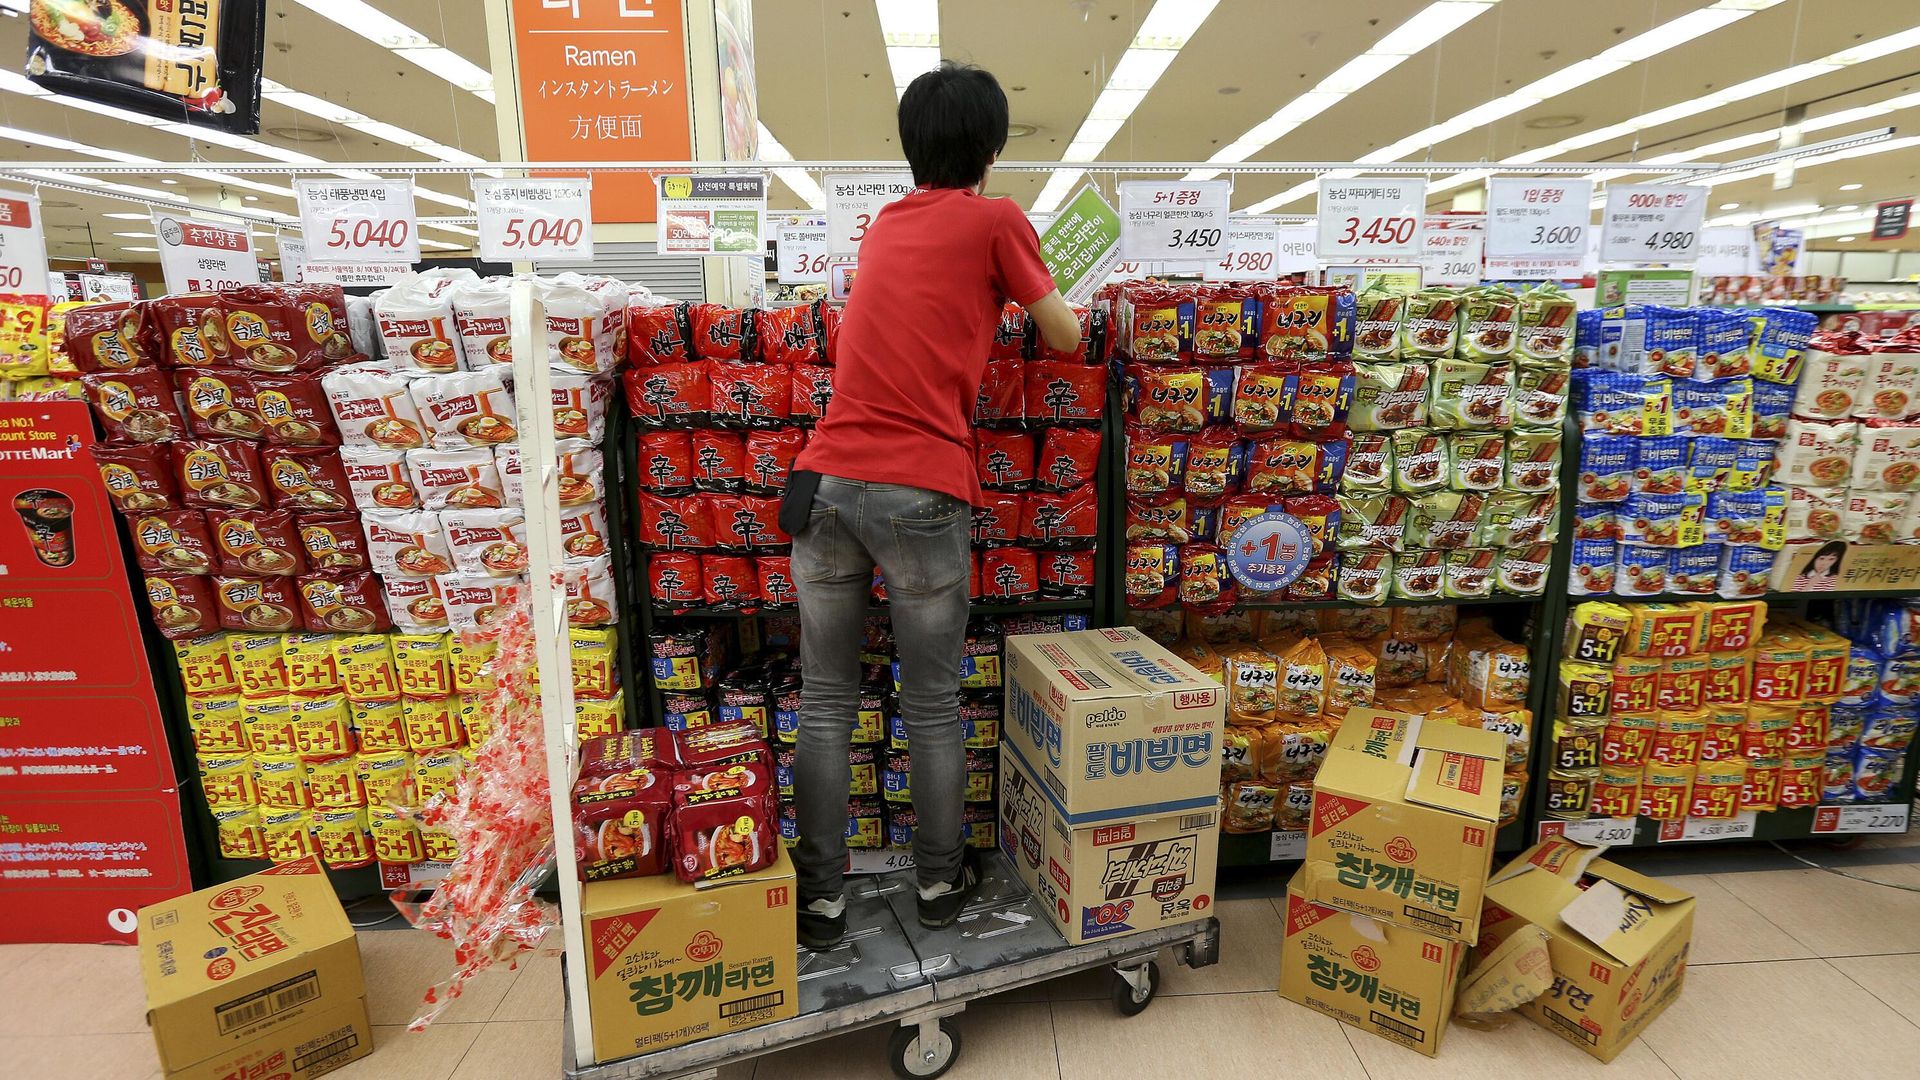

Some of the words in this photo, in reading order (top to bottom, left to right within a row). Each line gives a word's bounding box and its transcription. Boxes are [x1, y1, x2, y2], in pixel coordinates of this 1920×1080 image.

[565, 45, 637, 67] Ramen
[538, 79, 674, 100] インスタントラーメン
[569, 114, 643, 140] 方便面
[308, 188, 328, 200] 농심
[329, 188, 369, 201] 태풍냉면
[370, 188, 386, 200] 4입
[502, 188, 519, 200] 둥지
[520, 188, 552, 200] 비빔냉면
[728, 182, 758, 192] 특별혜택
[835, 184, 855, 196] 농심
[856, 184, 886, 196] 신라면
[1328, 188, 1347, 200] 농심
[1348, 188, 1385, 200] 짜파게티
[1386, 189, 1400, 200] 5입
[1522, 189, 1541, 203] 1입
[1541, 189, 1565, 203] 증정
[1153, 190, 1175, 204] 5+1
[1176, 190, 1201, 205] 증정
[1628, 193, 1664, 208] 900원
[1664, 193, 1688, 208] 할인
[1128, 210, 1142, 220] 농심
[1143, 210, 1163, 220] 너구리
[327, 219, 409, 250] 5,040
[502, 218, 583, 249] 5,040
[1058, 212, 1084, 239] 한번에
[1338, 216, 1416, 247] 3,450
[189, 227, 238, 248] 추천상품
[1055, 215, 1105, 262] 박스라면이
[1168, 228, 1222, 249] 3,450
[1531, 226, 1582, 245] 3,600
[1644, 231, 1694, 251] 4,980
[1063, 232, 1110, 280] 우리집까지!
[1283, 242, 1316, 256] 어린이
[197, 258, 227, 271] 삼양라면
[1219, 252, 1273, 271] 4,980
[1440, 262, 1476, 276] 3,040
[1277, 309, 1324, 330] 너구리
[643, 375, 677, 421] 辛
[1044, 378, 1079, 422] 辛
[1152, 387, 1199, 404] 너구리
[12, 418, 34, 428] NO.1
[28, 430, 57, 441] Store
[1267, 453, 1314, 470] 너구리
[731, 508, 765, 550] 辛
[1247, 563, 1286, 575] 추가증정
[658, 569, 684, 602] 辛
[994, 564, 1021, 598] 辛
[1580, 637, 1620, 662] 5+1
[187, 653, 235, 688] 5+1
[653, 659, 667, 668] 하나
[655, 668, 667, 678] 더
[677, 658, 696, 675] +1
[1239, 670, 1276, 685] 너구리
[1340, 670, 1375, 685] 너구리
[1756, 670, 1800, 698] 5+1
[1179, 691, 1211, 705] 행사용
[863, 713, 881, 729] +1
[1085, 707, 1127, 729] paldo
[409, 711, 457, 745] 5+1
[1108, 731, 1213, 778] 비빔면
[1285, 743, 1327, 758] 너구리
[1561, 742, 1597, 768] 5+1
[312, 774, 350, 803] 5+1
[1692, 793, 1735, 817] 5+1
[1320, 804, 1350, 828] 멀티팩
[1867, 815, 1905, 828] 2,270
[1095, 827, 1132, 844] 멀티팩
[1275, 833, 1288, 842] 농심
[1288, 832, 1306, 841] 너구리
[1595, 828, 1632, 841] 4,500
[1389, 847, 1411, 859] 오뚜기
[1102, 843, 1191, 884] 짜파게티
[386, 872, 407, 883] 추천
[1156, 878, 1183, 895] 올리브
[1335, 852, 1460, 913] 참깨라면
[1160, 899, 1190, 916] 농심
[1294, 909, 1320, 930] 멀티팩
[213, 903, 289, 962] 진라면
[603, 922, 638, 960] 멀티팩
[691, 943, 717, 957] 오뚜기
[752, 954, 774, 967] Ramen
[629, 961, 774, 1017] 참깨라면
[1307, 953, 1421, 1022] 참깨라면
